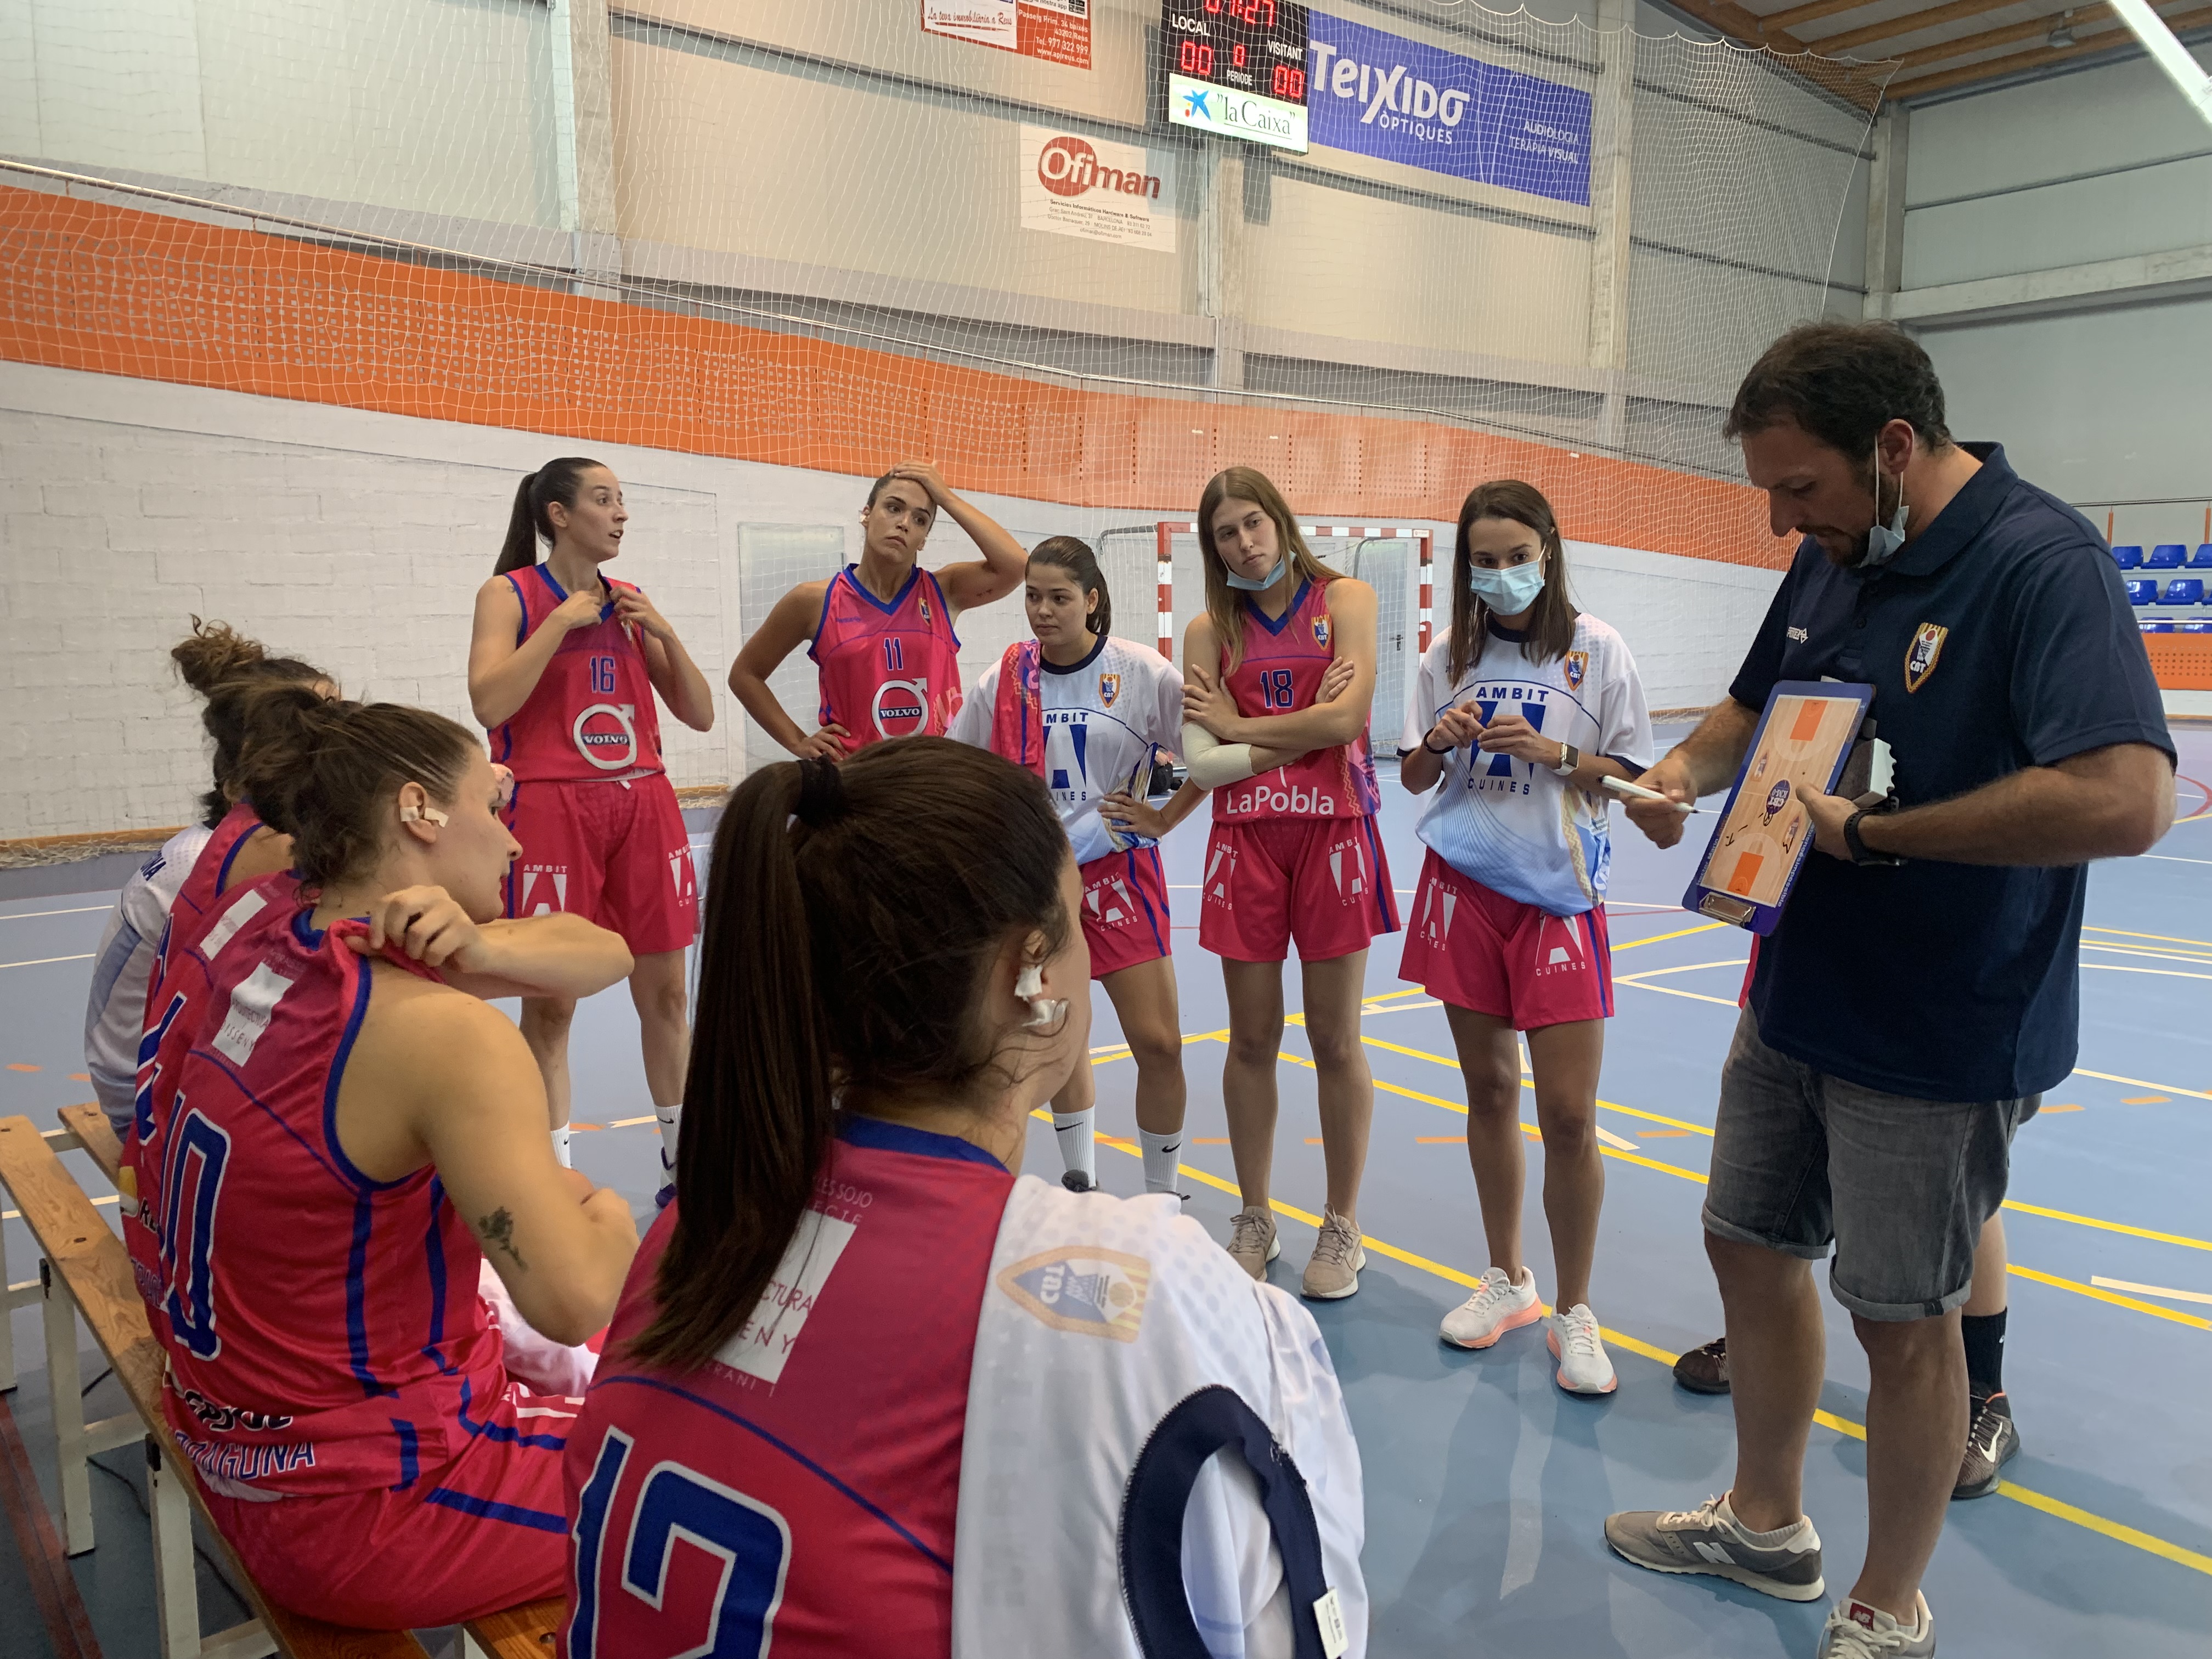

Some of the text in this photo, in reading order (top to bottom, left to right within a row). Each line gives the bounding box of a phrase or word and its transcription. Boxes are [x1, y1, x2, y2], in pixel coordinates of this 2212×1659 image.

[998, 12, 1012, 25] Reus
[1018, 9, 1042, 22] Passeig
[1172, 13, 1210, 36] LOCAL
[1054, 28, 1088, 42] 43202 Reus
[1048, 37, 1060, 48] 977
[1062, 41, 1074, 52] 322
[1076, 44, 1088, 55] 999
[1267, 40, 1303, 60] VISITANT
[1037, 48, 1088, 64] www.apireus.com
[1181, 41, 1212, 75] 00
[1274, 65, 1304, 98] 00
[1227, 69, 1252, 86] PERIODE
[1524, 121, 1579, 145] AUDIOLOGIA
[1510, 136, 1578, 164] TERAPIA VISUAL
[1041, 146, 1161, 199] Ofiman
[1097, 215, 1123, 224] BARCELONA
[1102, 208, 1124, 218] Hardware
[1130, 213, 1149, 222] Software
[1094, 222, 1111, 230] MOLINS
[884, 637, 903, 671] 11
[590, 656, 616, 694] 16
[1260, 669, 1294, 708] 18
[1476, 686, 1549, 702] AMBIT
[880, 707, 920, 717] VOLVO
[1045, 712, 1089, 724] MBIT
[584, 733, 629, 745] VOLVO
[1467, 777, 1531, 796] CUINES
[1054, 791, 1086, 801] INES
[1227, 785, 1335, 816] LaPobla
[523, 864, 567, 873] AMBIT
[1536, 961, 1586, 977] CUINES
[761, 1280, 813, 1312] CTURA
